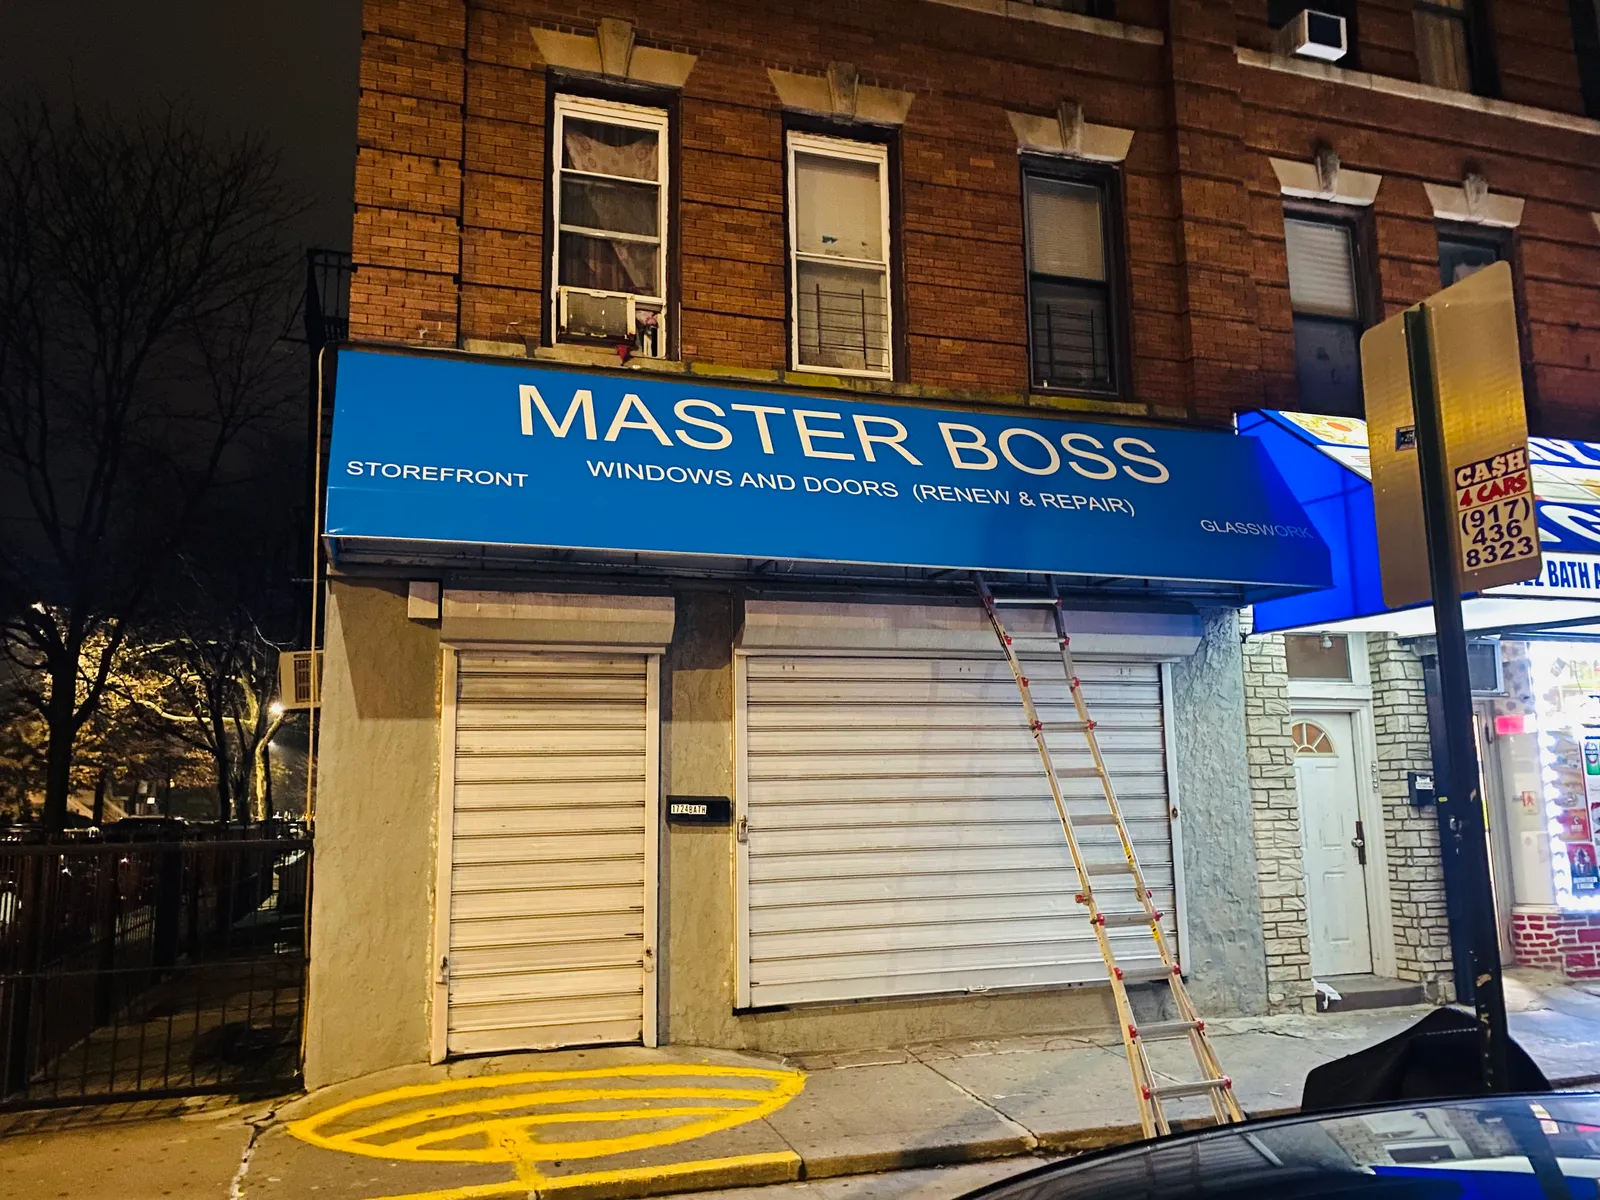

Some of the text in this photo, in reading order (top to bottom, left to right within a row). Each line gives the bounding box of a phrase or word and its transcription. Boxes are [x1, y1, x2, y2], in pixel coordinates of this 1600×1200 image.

[518, 384, 1170, 484] MASTER BOSS
[346, 460, 528, 488] STOREFRONT
[586, 460, 1135, 518] WINDOWS AND DOORS (RENEW & REPAIR)
[1459, 472, 1528, 508] 4 CARS
[1200, 519, 1314, 539] GLASSWORK
[1461, 497, 1530, 535] (917)
[1471, 519, 1523, 546] 436
[1465, 536, 1534, 568] 8323
[1546, 560, 1591, 589] BATH
